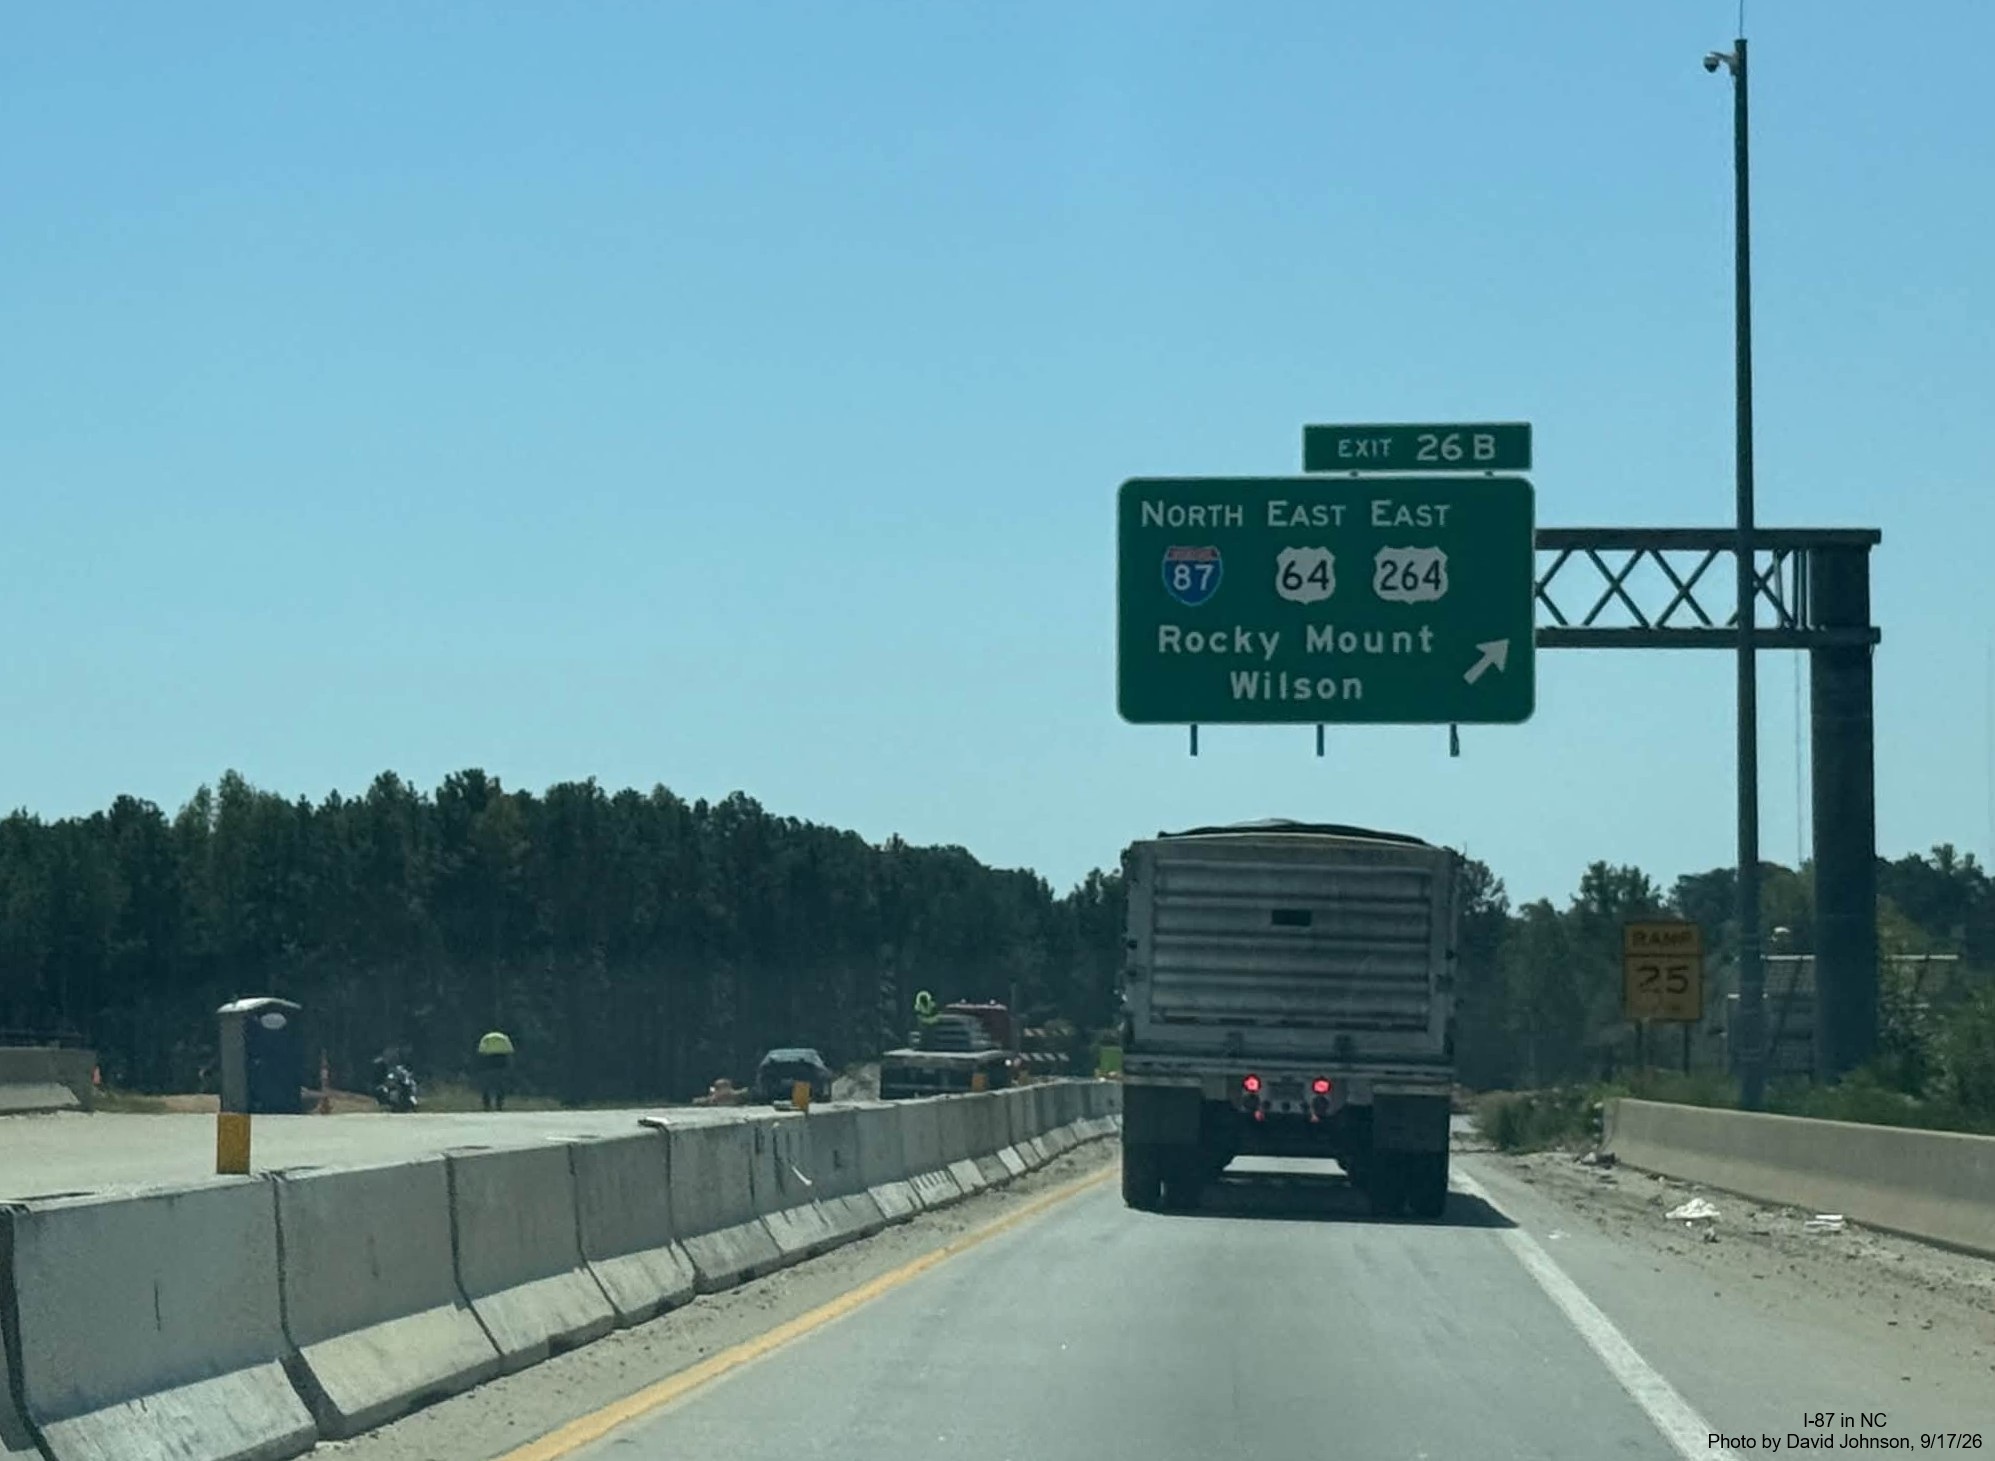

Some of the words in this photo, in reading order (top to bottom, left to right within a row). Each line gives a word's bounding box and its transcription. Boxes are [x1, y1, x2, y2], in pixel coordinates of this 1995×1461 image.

[1338, 437, 1393, 459] EXIT
[1416, 433, 1463, 461] 26
[1473, 433, 1497, 461] B
[1141, 500, 1244, 528] NORTH
[1267, 500, 1347, 528] EAST
[1370, 500, 1451, 528] EAST
[1173, 563, 1214, 592] 87
[1281, 559, 1331, 592] 64
[1378, 559, 1442, 592] 264
[1158, 624, 1280, 661] Rocky
[1306, 624, 1435, 655] Mount
[1229, 670, 1363, 701] Wilson
[1631, 930, 1692, 946] RAMP
[1637, 965, 1690, 995] 25
